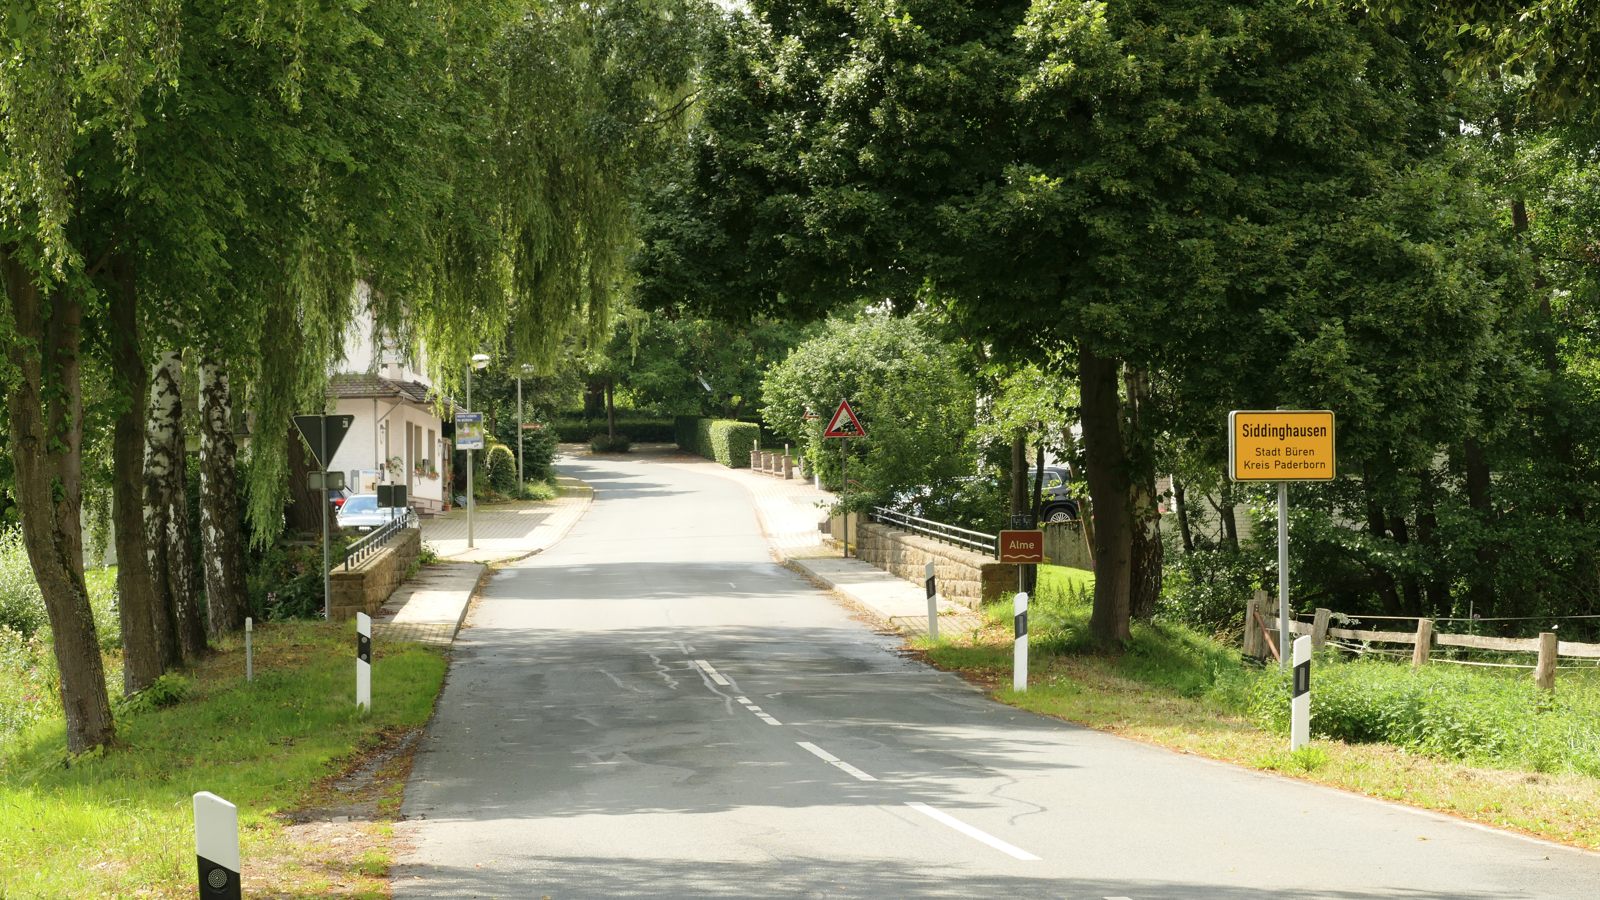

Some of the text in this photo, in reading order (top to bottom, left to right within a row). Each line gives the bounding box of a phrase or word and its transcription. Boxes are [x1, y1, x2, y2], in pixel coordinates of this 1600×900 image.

[1242, 423, 1327, 441] Siddinghausen
[1255, 446, 1315, 457] Stadt Büren
[1243, 460, 1326, 470] Kreis Paderborn
[1009, 540, 1035, 550] Alme
